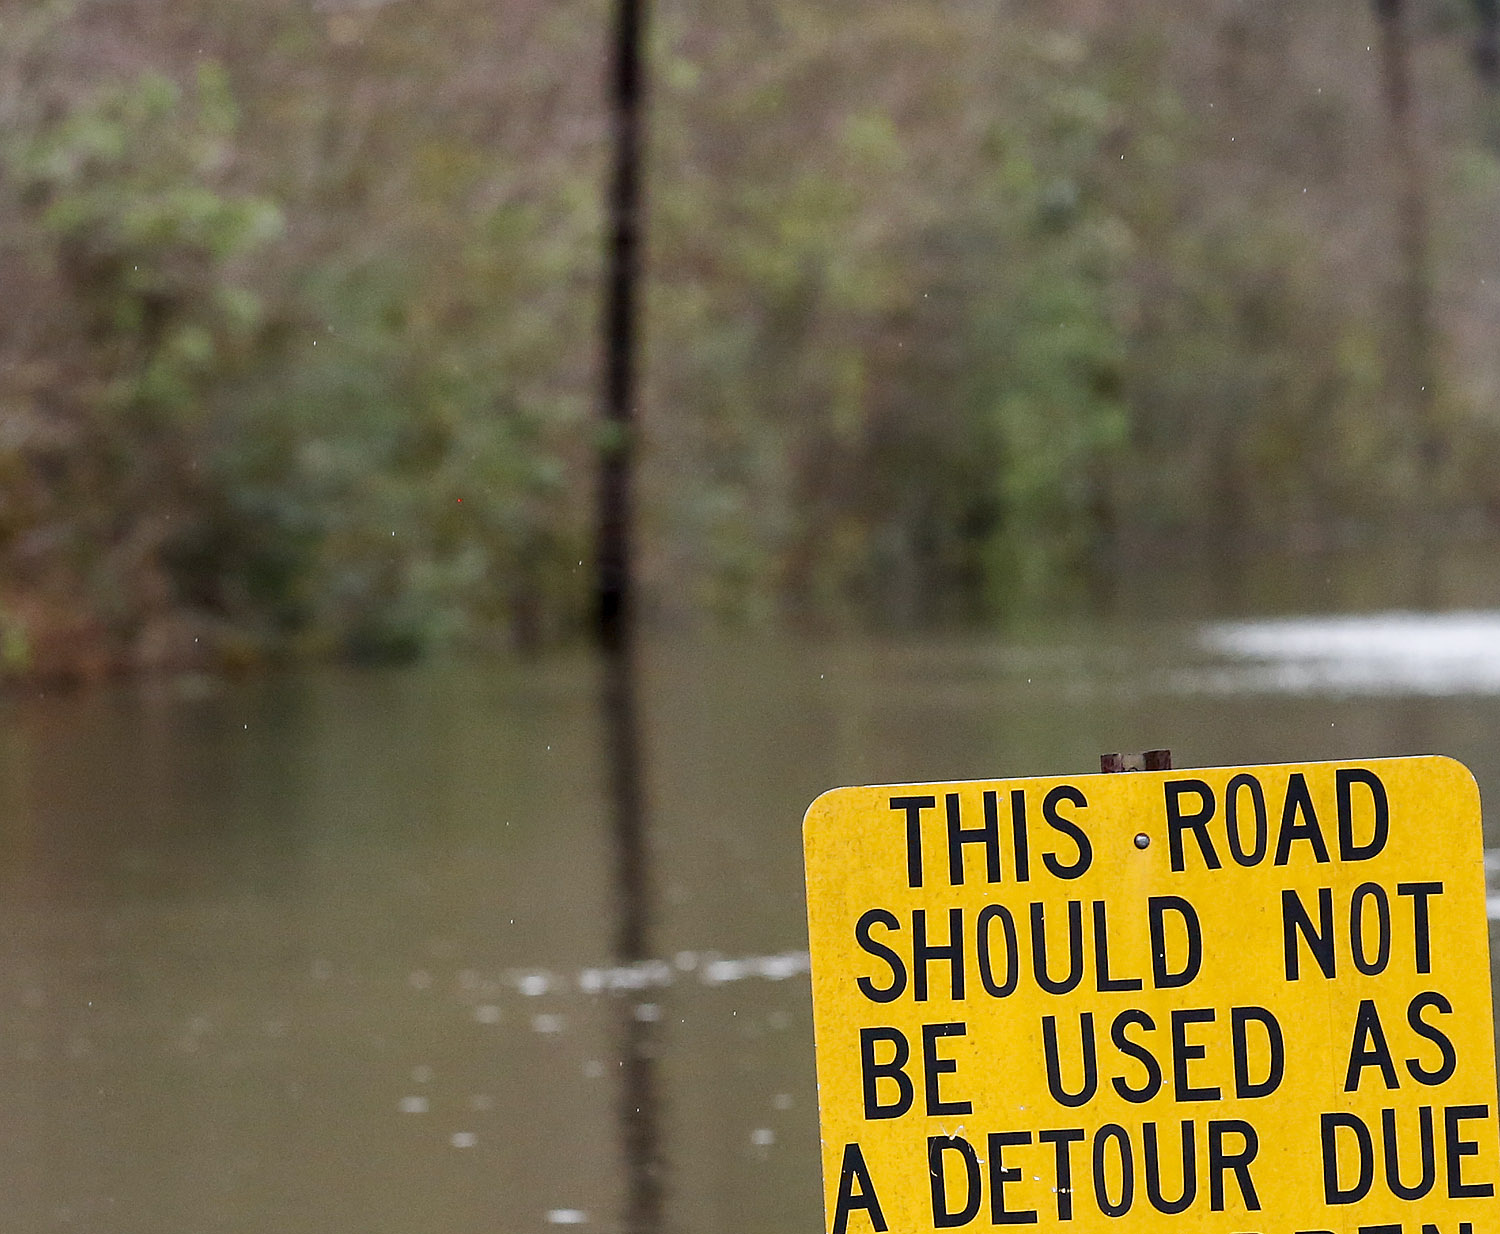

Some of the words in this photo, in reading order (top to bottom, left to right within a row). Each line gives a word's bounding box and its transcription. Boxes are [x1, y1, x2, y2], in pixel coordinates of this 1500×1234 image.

[890, 786, 1093, 888] THIS
[1164, 769, 1390, 872] ROAD
[855, 896, 1203, 1004] SHOULD
[1282, 881, 1443, 982] NOT
[860, 1022, 974, 1121] BE
[1042, 1006, 1285, 1108] USED
[1343, 991, 1457, 1092] AS
[928, 1120, 1261, 1229] DETOUR
[1320, 1104, 1494, 1206] DUE
